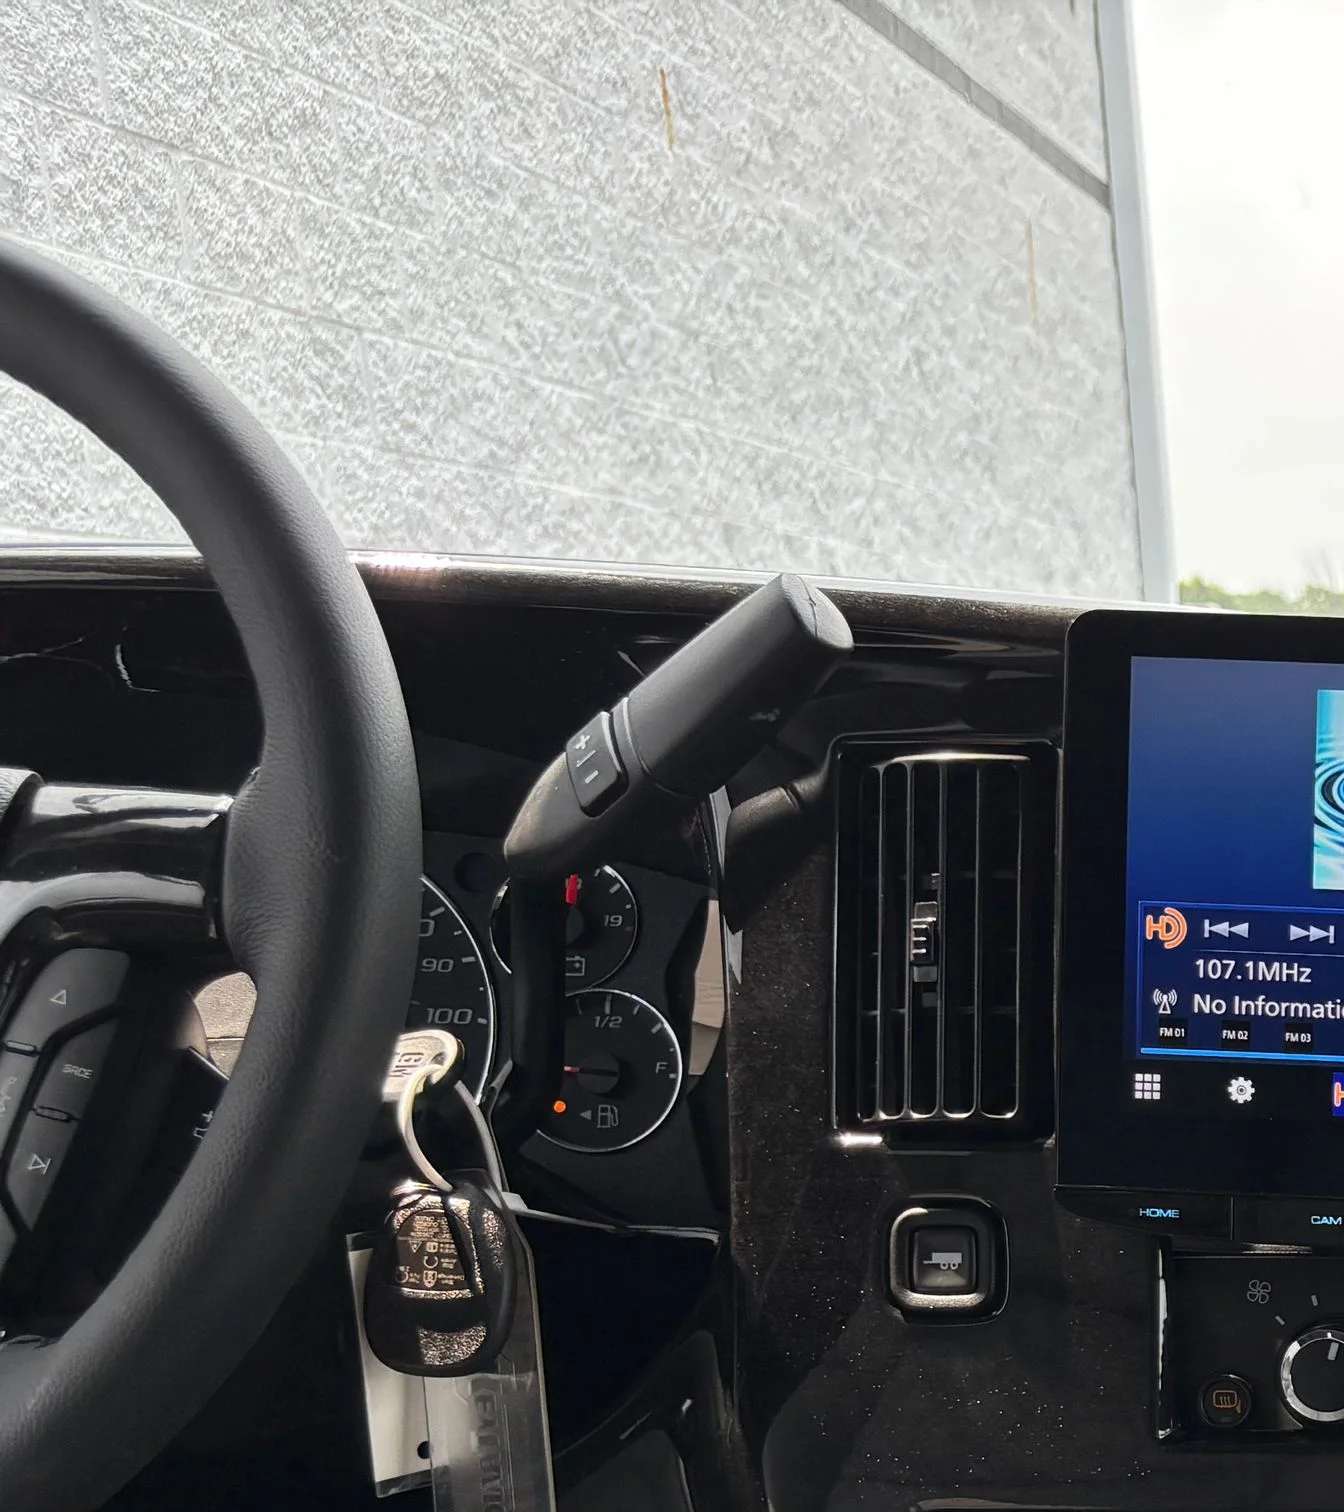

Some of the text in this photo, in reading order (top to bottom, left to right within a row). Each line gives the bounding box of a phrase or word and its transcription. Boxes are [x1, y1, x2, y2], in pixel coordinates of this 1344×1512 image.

[604, 914, 622, 928] 19
[421, 958, 454, 973] 90
[1195, 959, 1312, 983] 107.1MHz
[1193, 994, 1226, 1014] No
[426, 1008, 473, 1025] 100
[595, 1016, 622, 1028] 1/2
[1159, 1027, 1185, 1037] FM 01
[1222, 1030, 1249, 1041] FM 02
[1285, 1032, 1312, 1043] FM 03
[655, 1062, 667, 1073] F
[1139, 1207, 1180, 1219] HOME
[1310, 1215, 1343, 1226] CAM
